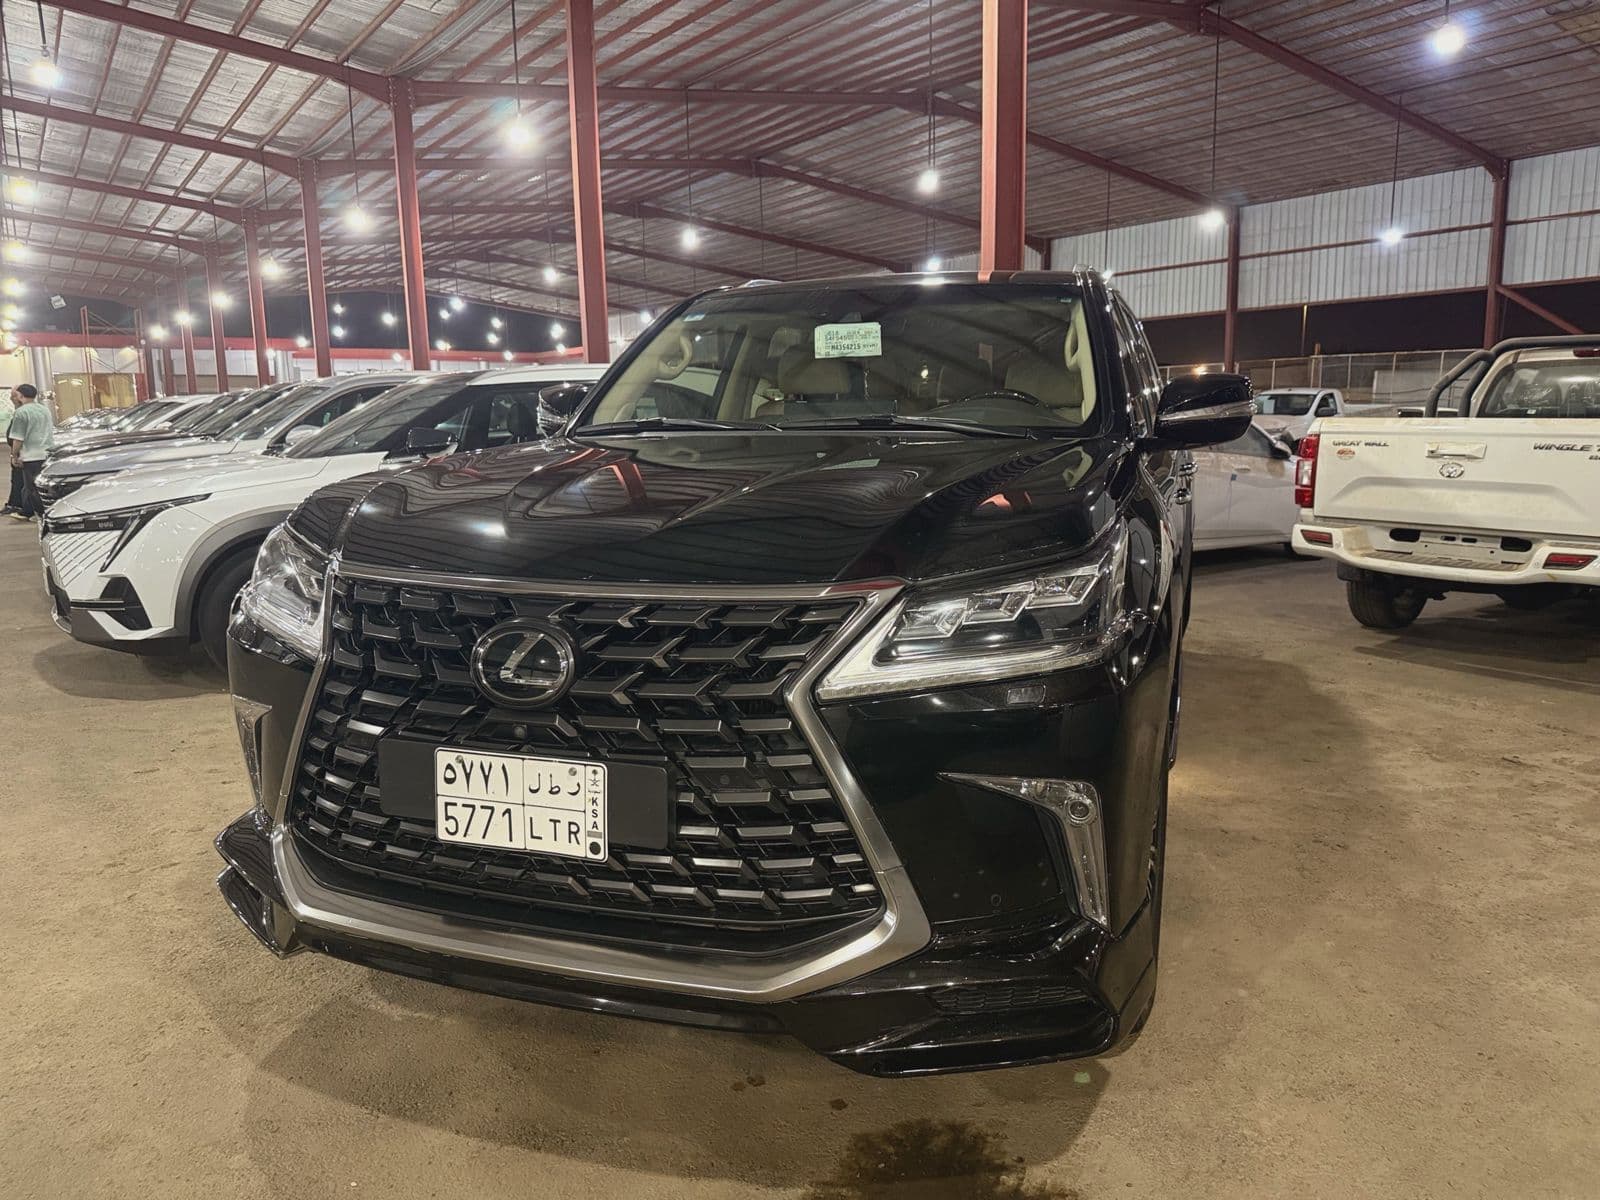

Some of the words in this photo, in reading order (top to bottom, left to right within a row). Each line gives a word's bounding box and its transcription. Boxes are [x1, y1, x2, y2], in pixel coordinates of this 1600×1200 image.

[1533, 442, 1593, 452] WINGLE
[443, 759, 509, 797] ٥٧٧١
[444, 801, 513, 842] 5771
[529, 816, 581, 845] LTR
[591, 797, 599, 831] KSA
